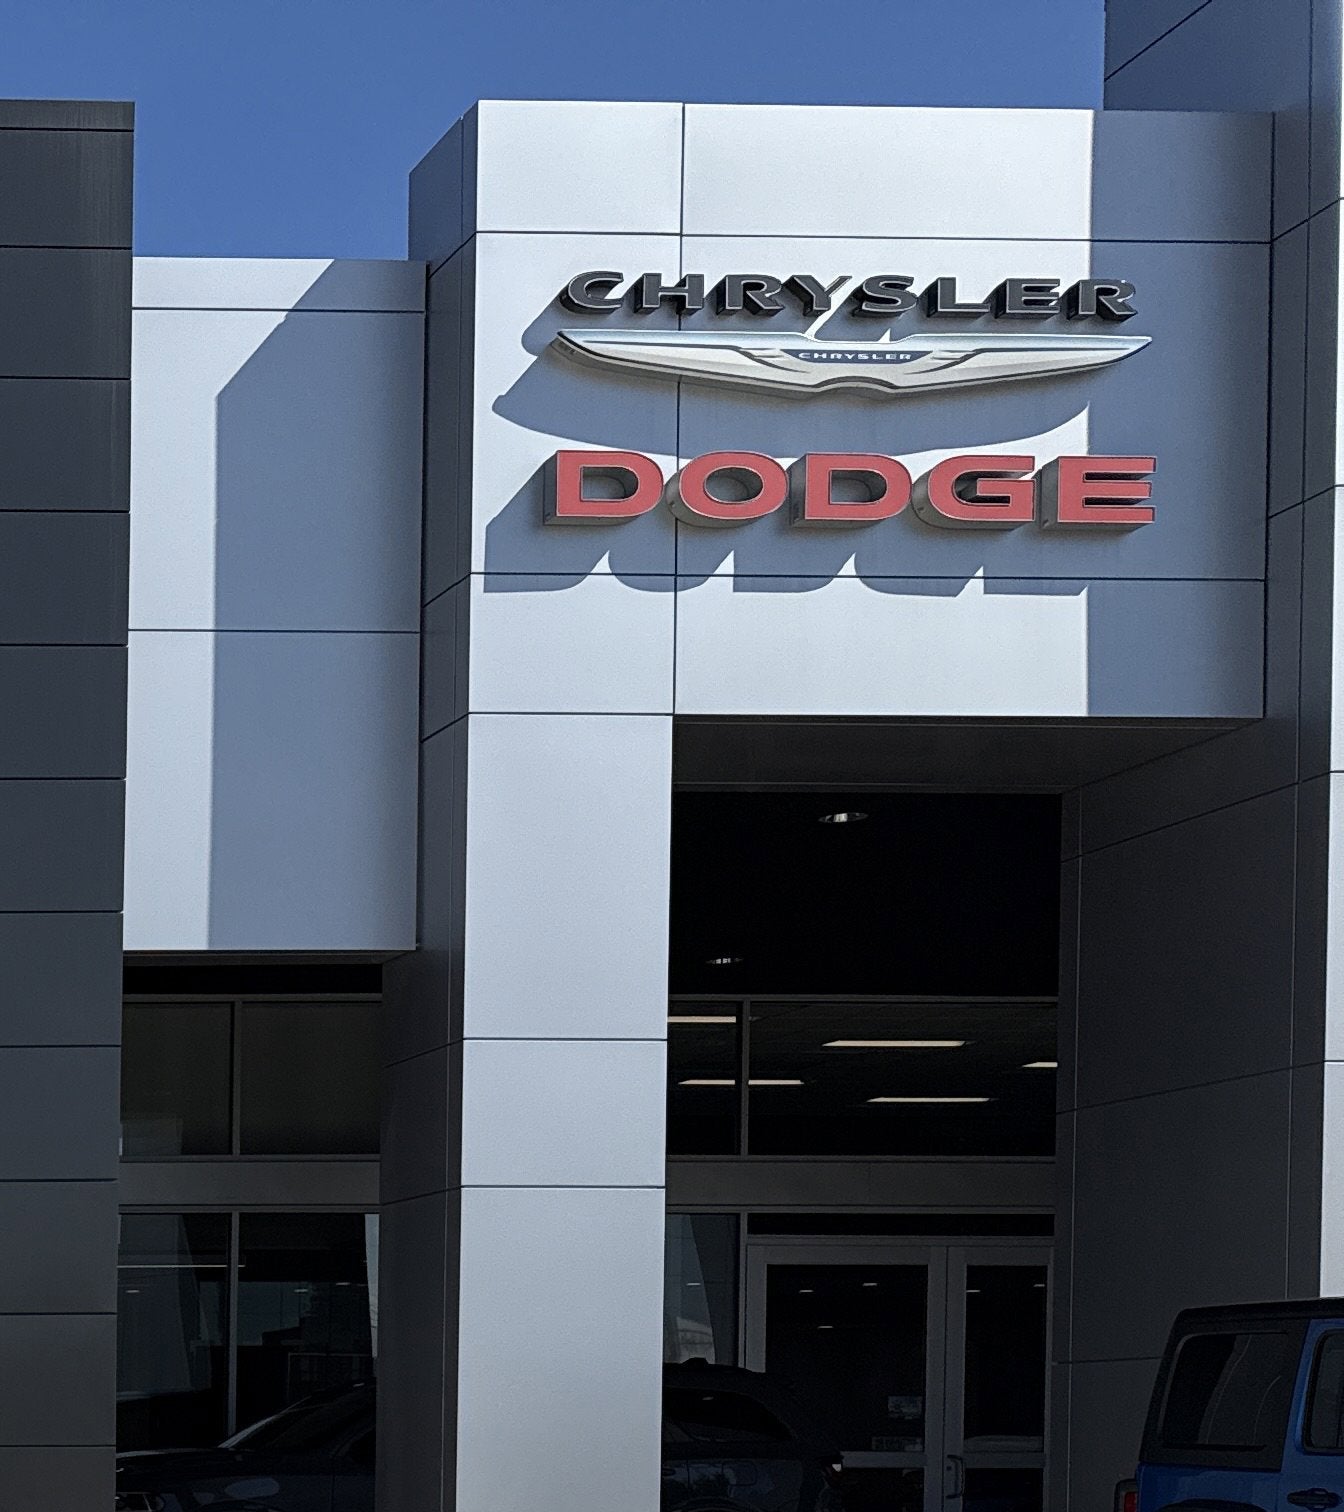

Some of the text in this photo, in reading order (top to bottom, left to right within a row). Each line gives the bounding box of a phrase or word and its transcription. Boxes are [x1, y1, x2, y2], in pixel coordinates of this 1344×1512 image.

[560, 270, 1140, 320] CHRYSLER
[798, 352, 912, 361] CHRYSLER
[546, 449, 1158, 525] DODGE
